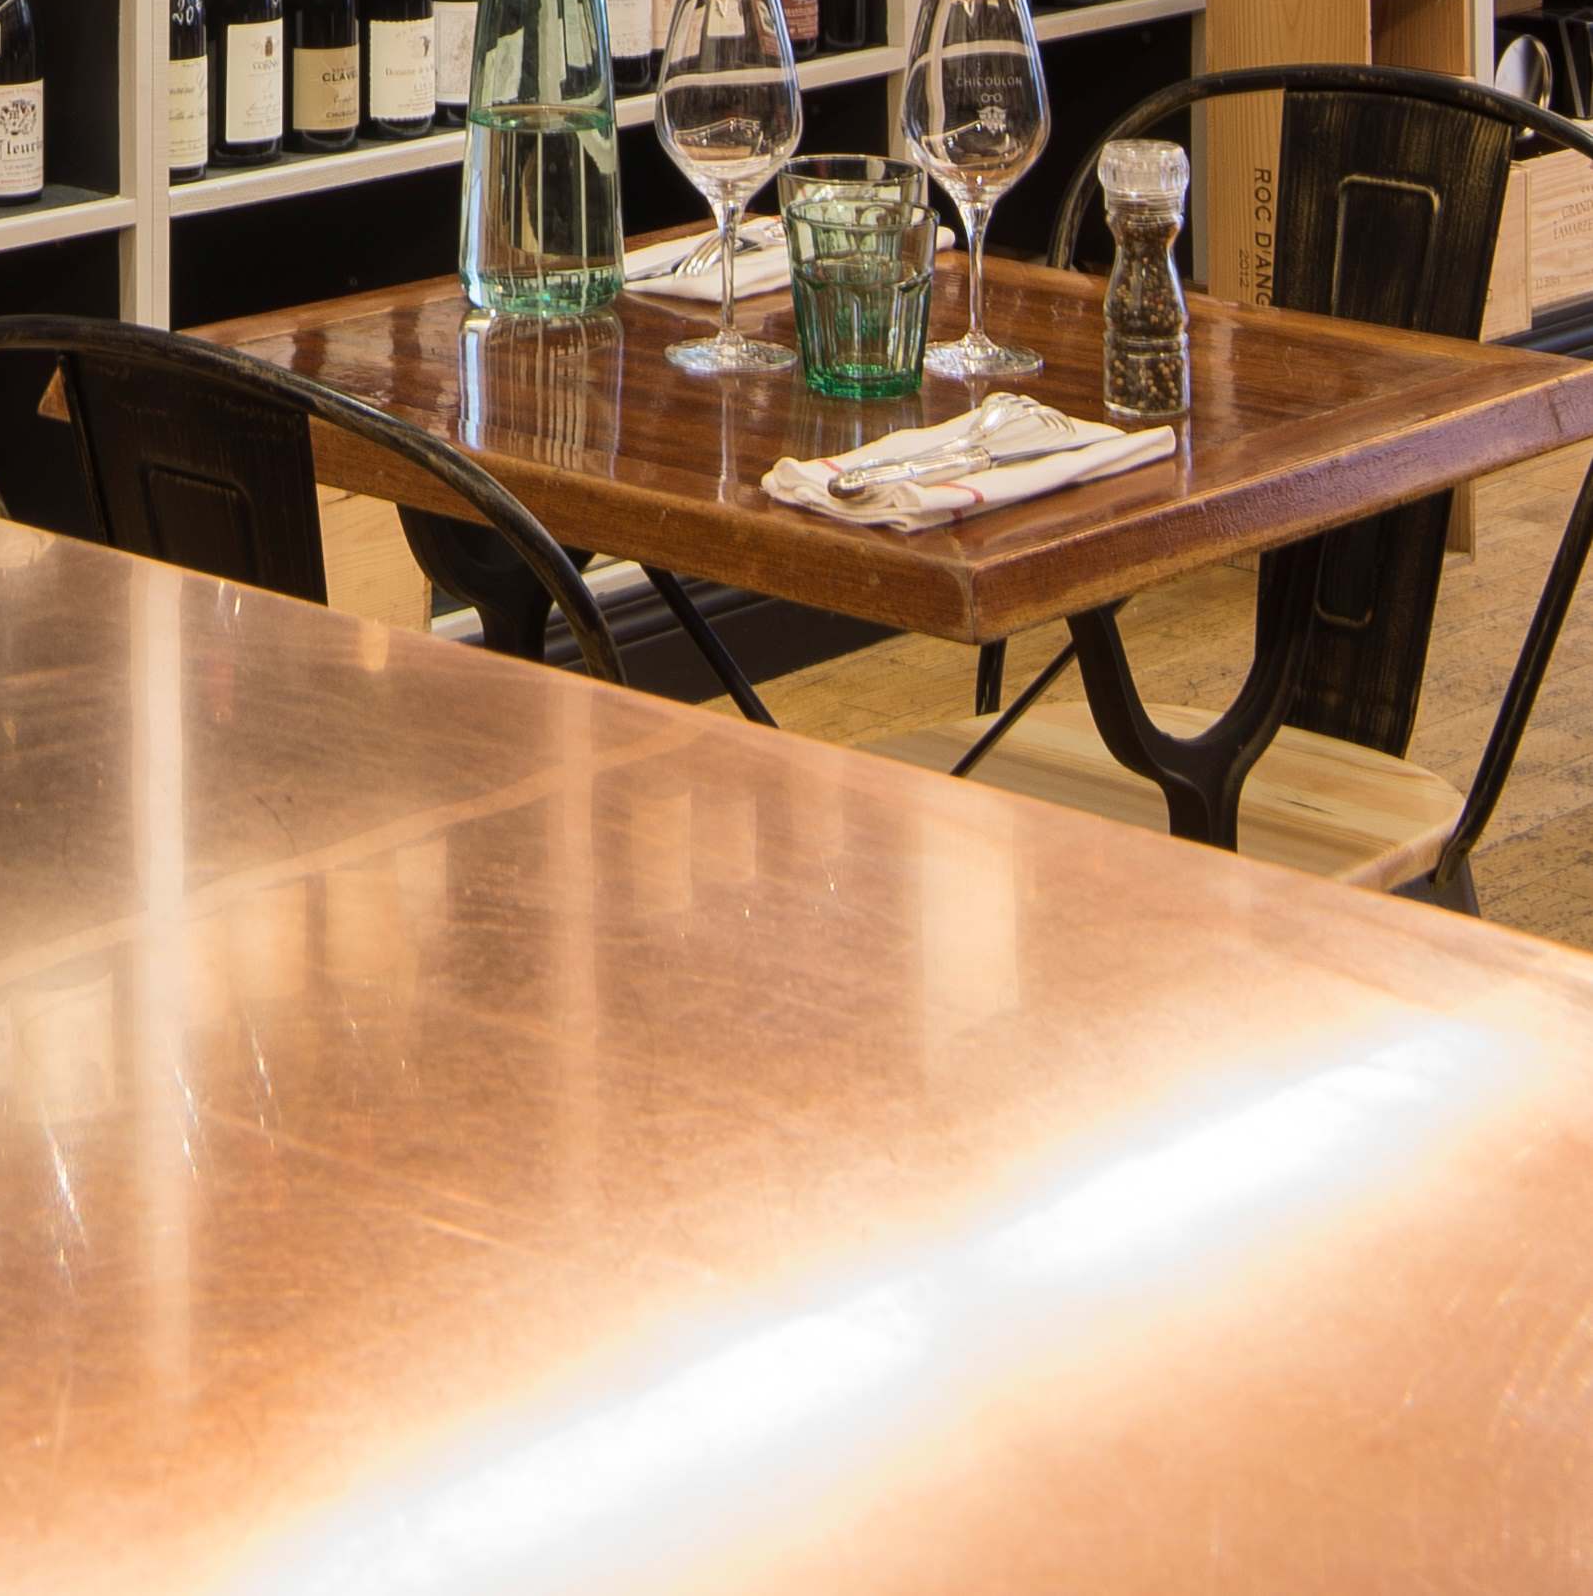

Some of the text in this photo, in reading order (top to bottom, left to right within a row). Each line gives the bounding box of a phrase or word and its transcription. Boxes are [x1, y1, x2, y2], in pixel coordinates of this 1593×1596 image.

[1239, 248, 1250, 289] 2012
[1255, 167, 1272, 307] ROC D'ANG
